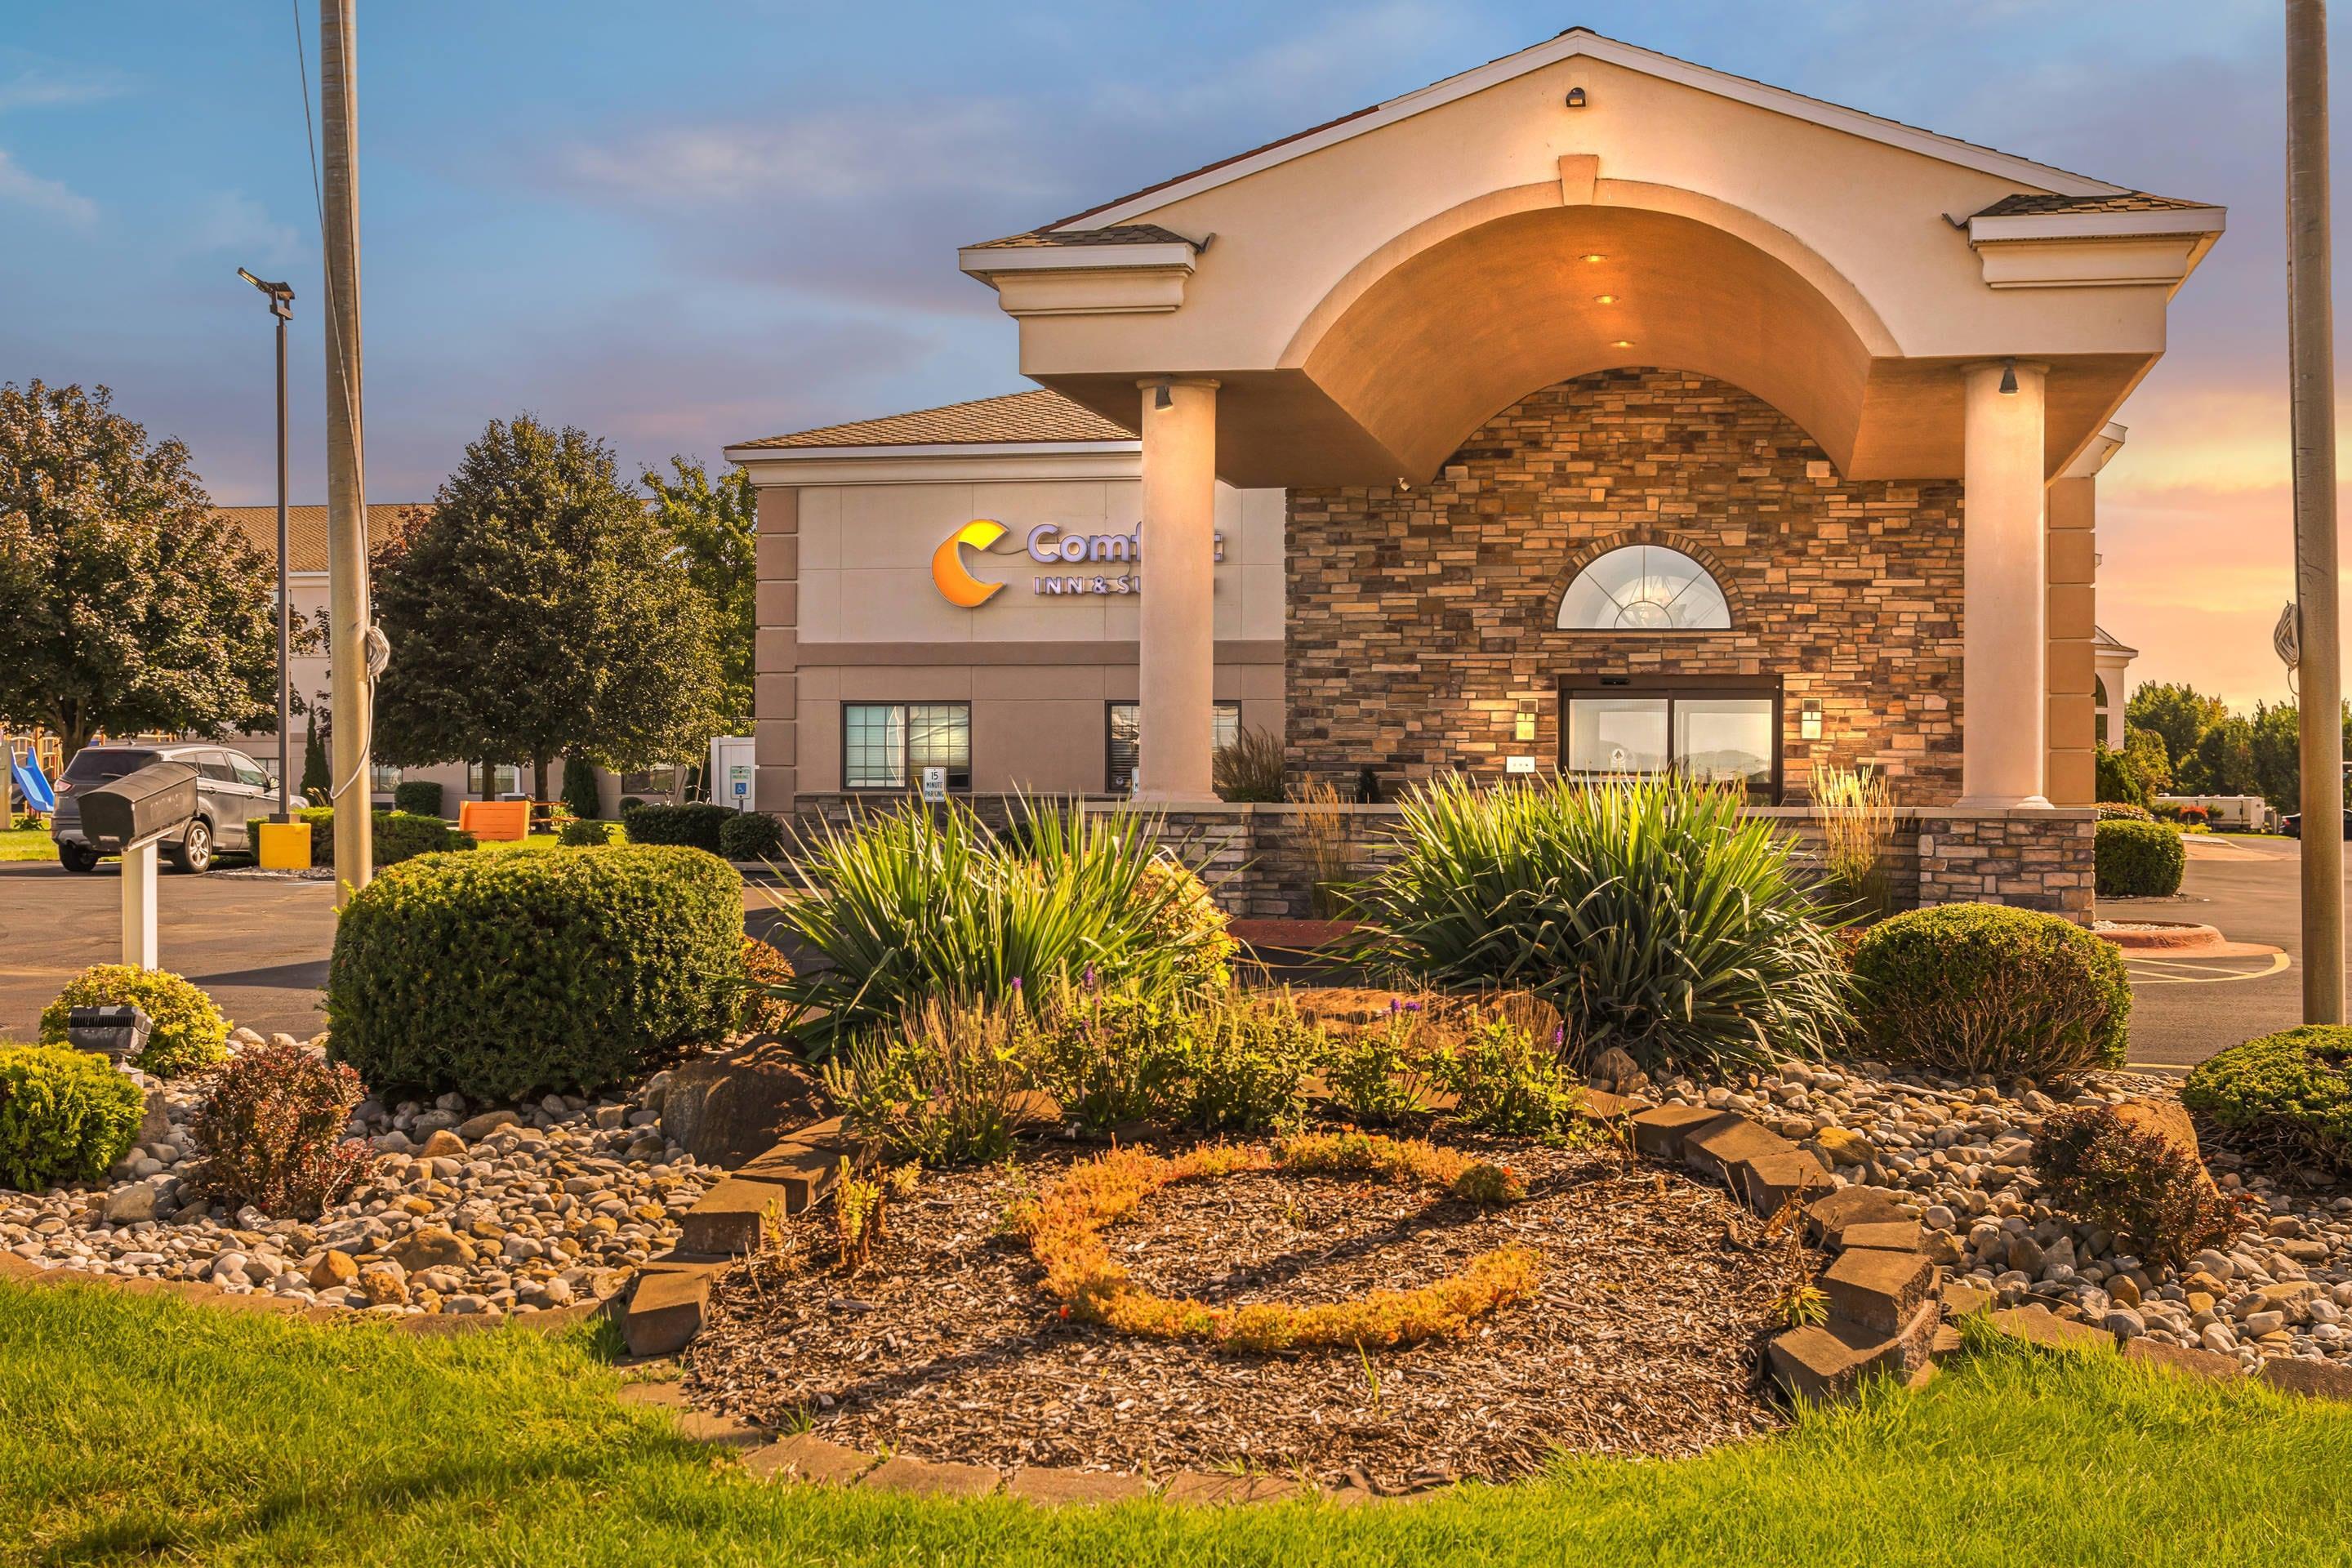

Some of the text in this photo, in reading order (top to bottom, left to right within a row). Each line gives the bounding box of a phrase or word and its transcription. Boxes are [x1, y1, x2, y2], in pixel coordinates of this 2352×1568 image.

[1027, 522, 1223, 563] Comf
[1034, 576, 1085, 595] INN
[1092, 575, 1110, 595] &
[931, 771, 938, 780] 15
